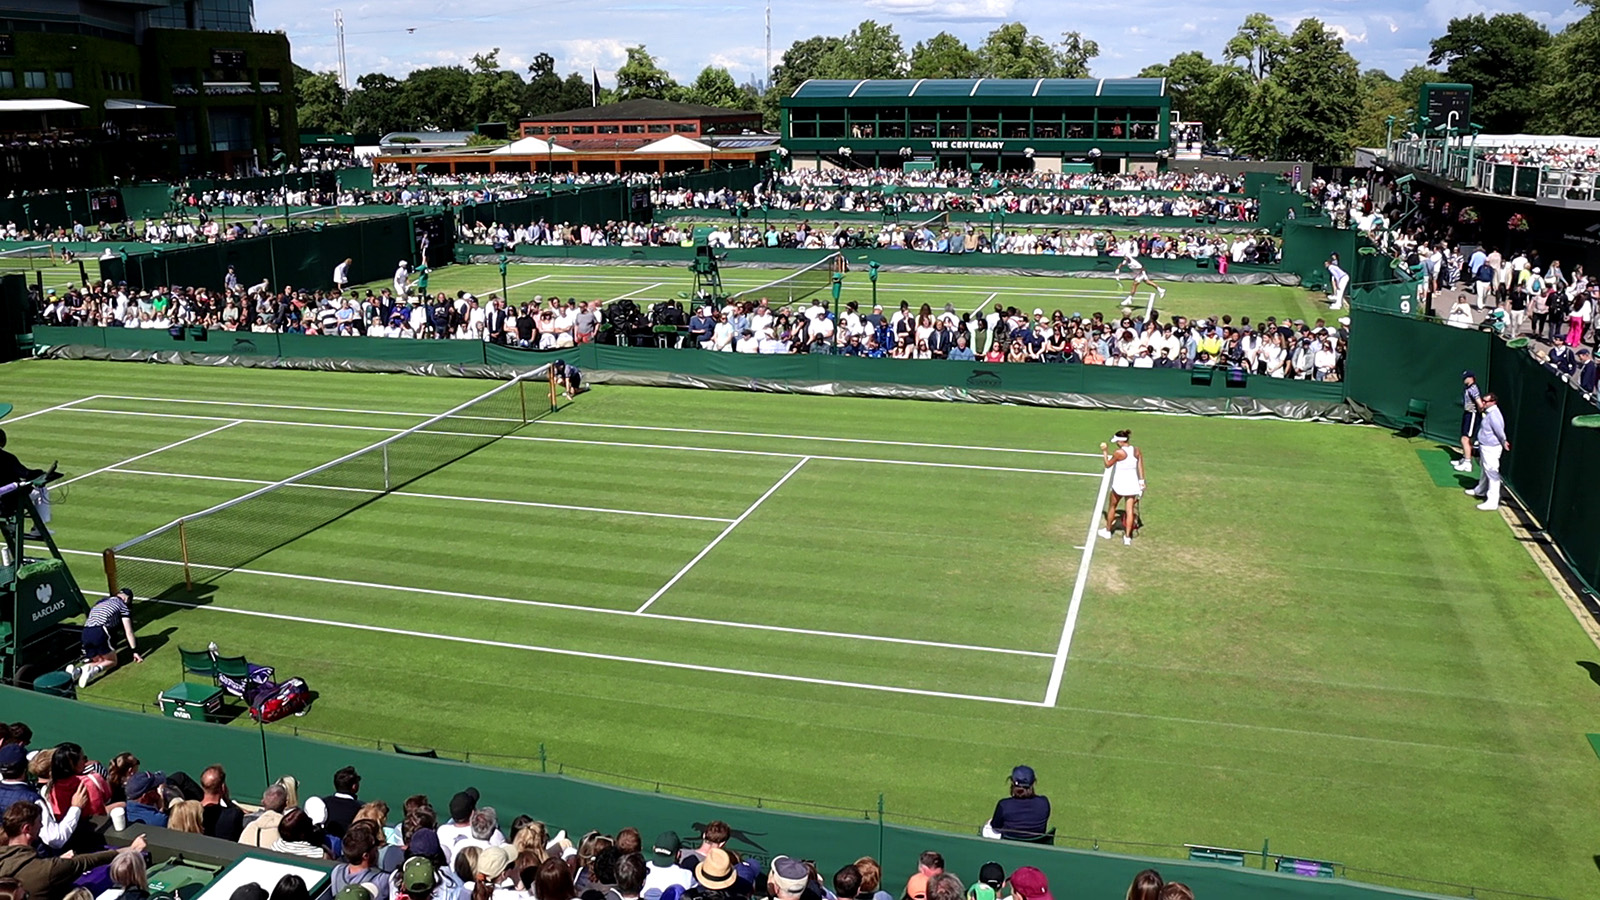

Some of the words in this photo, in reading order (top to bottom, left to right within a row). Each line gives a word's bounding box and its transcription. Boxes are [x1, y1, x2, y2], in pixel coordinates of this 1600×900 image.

[931, 141, 949, 149] THE
[951, 141, 1004, 149] CENTENARY
[1400, 300, 1410, 314] 9
[32, 599, 66, 621] BARCLAYS
[173, 711, 191, 719] evian
